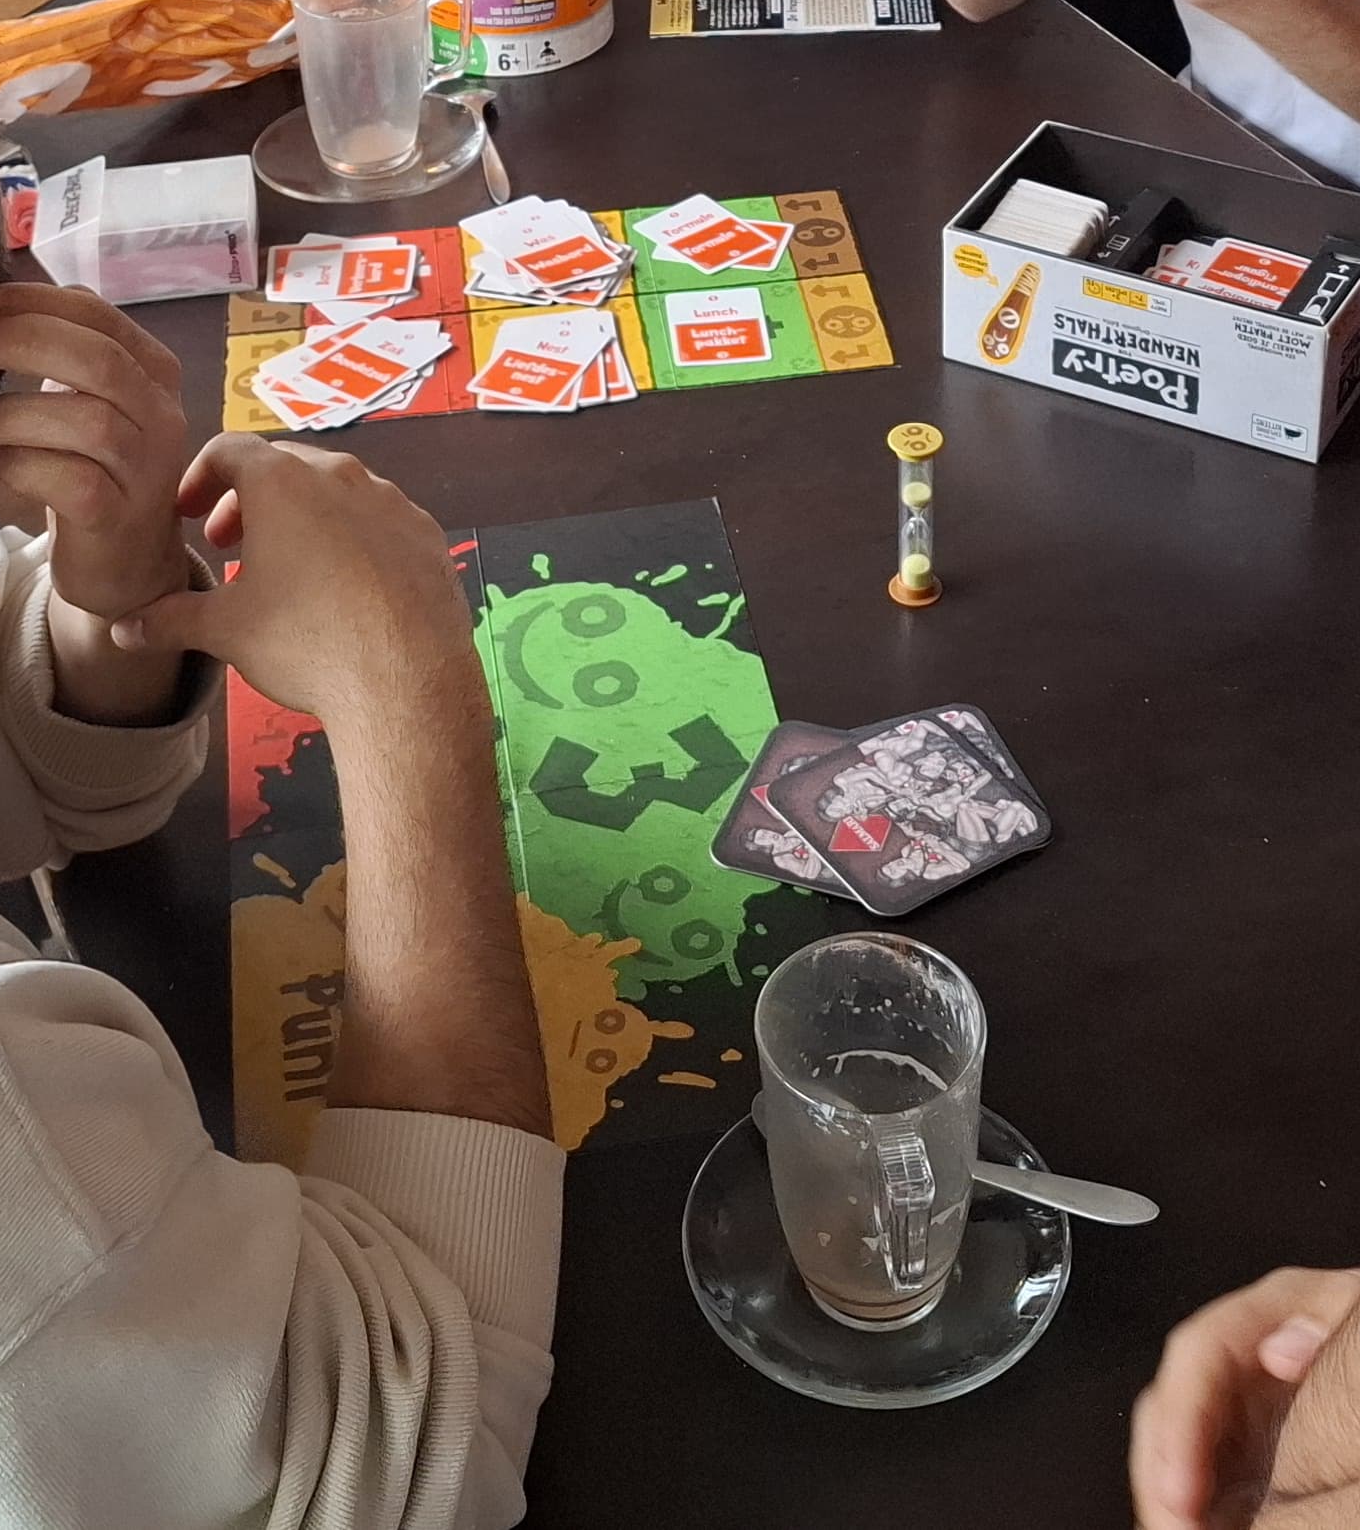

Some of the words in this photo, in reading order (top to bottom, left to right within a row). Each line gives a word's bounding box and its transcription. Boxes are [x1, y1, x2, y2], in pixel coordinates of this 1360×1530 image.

[501, 43, 516, 51] AGE
[498, 54, 521, 71] 6+
[662, 212, 715, 238] Formule
[524, 234, 557, 248] Was
[681, 230, 737, 257] Formule
[693, 307, 739, 319] Lunch
[690, 325, 747, 339] Lunch-
[1234, 322, 1273, 340] PRATEN
[1237, 333, 1258, 344] GOED
[536, 341, 570, 354] Nest
[694, 335, 748, 351] pakket
[1054, 312, 1201, 368] NEANDERTHALS
[1261, 339, 1271, 347] JE
[1278, 334, 1311, 350] MOET
[503, 356, 569, 377] Liefdes-
[510, 371, 547, 385] nest
[1062, 347, 1190, 410] Poetry
